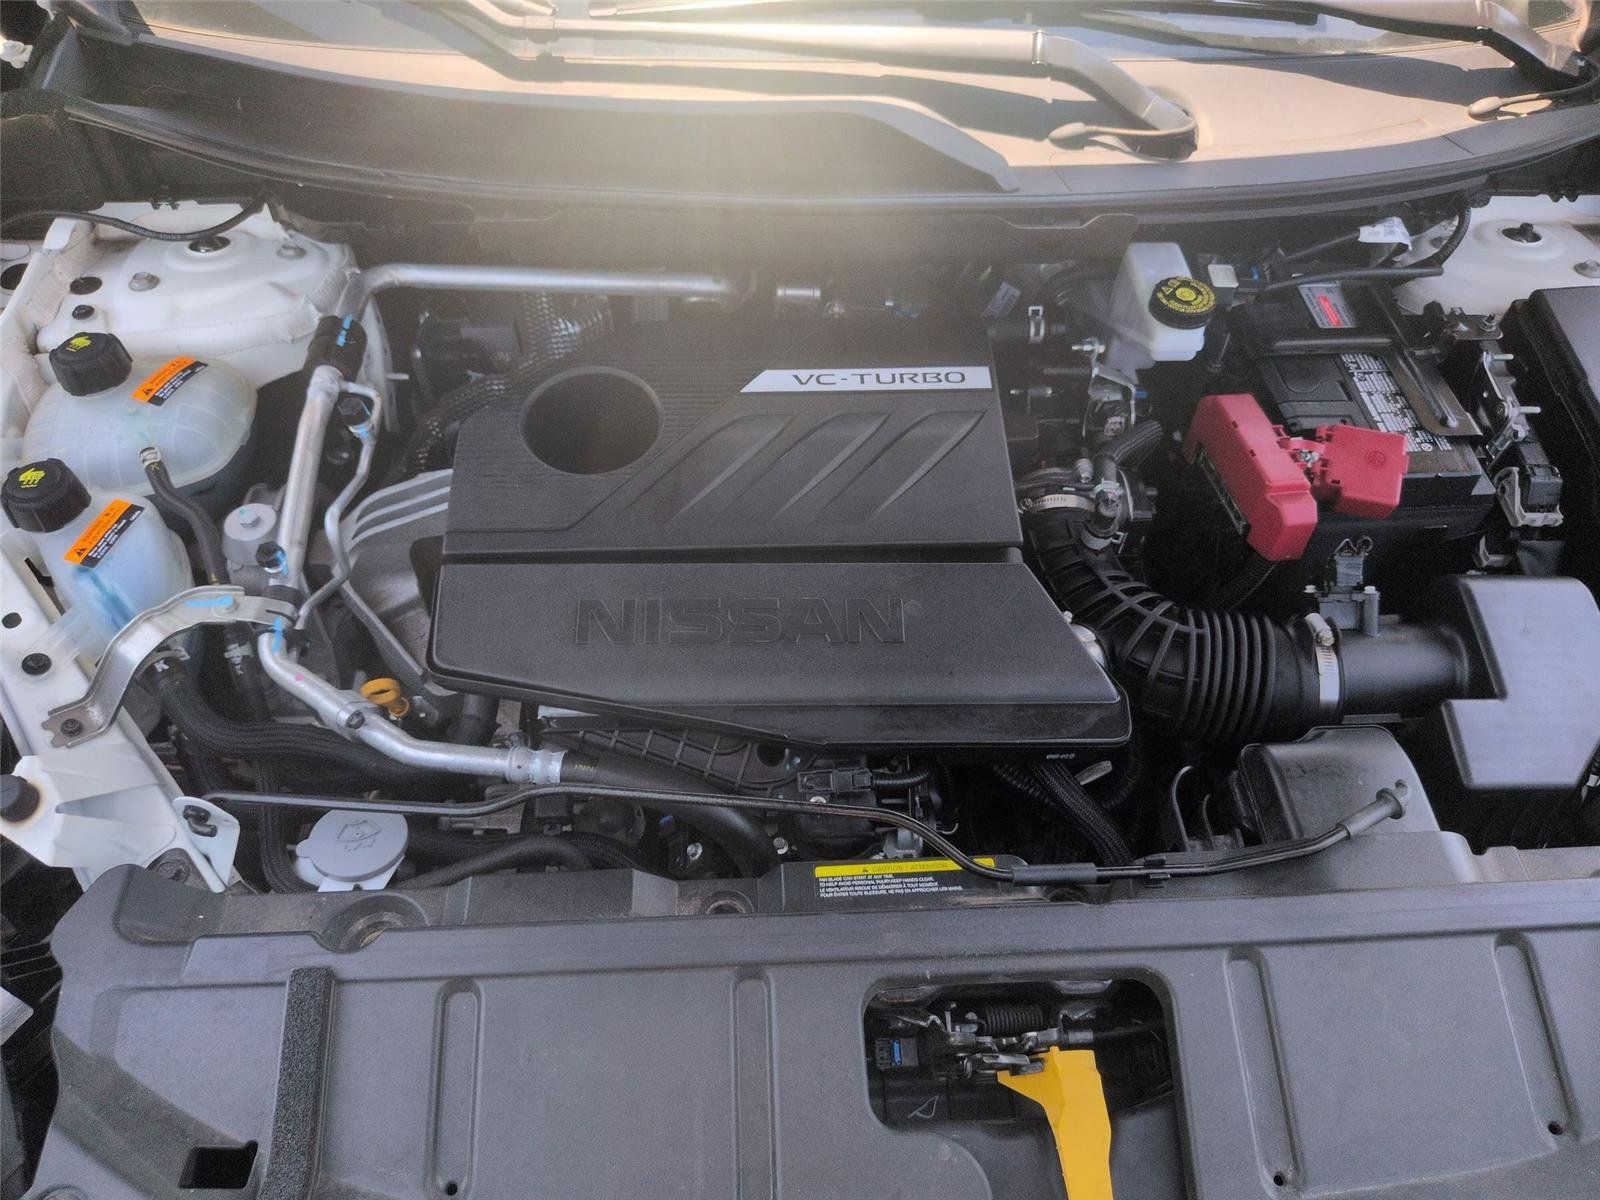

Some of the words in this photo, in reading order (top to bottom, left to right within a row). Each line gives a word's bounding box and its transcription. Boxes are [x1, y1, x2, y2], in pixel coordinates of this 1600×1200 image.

[792, 371, 966, 386] VC-TURBO
[575, 598, 906, 644] NISSAN
[872, 864, 903, 873] CAUTION
[910, 862, 948, 871] ATTENTION
